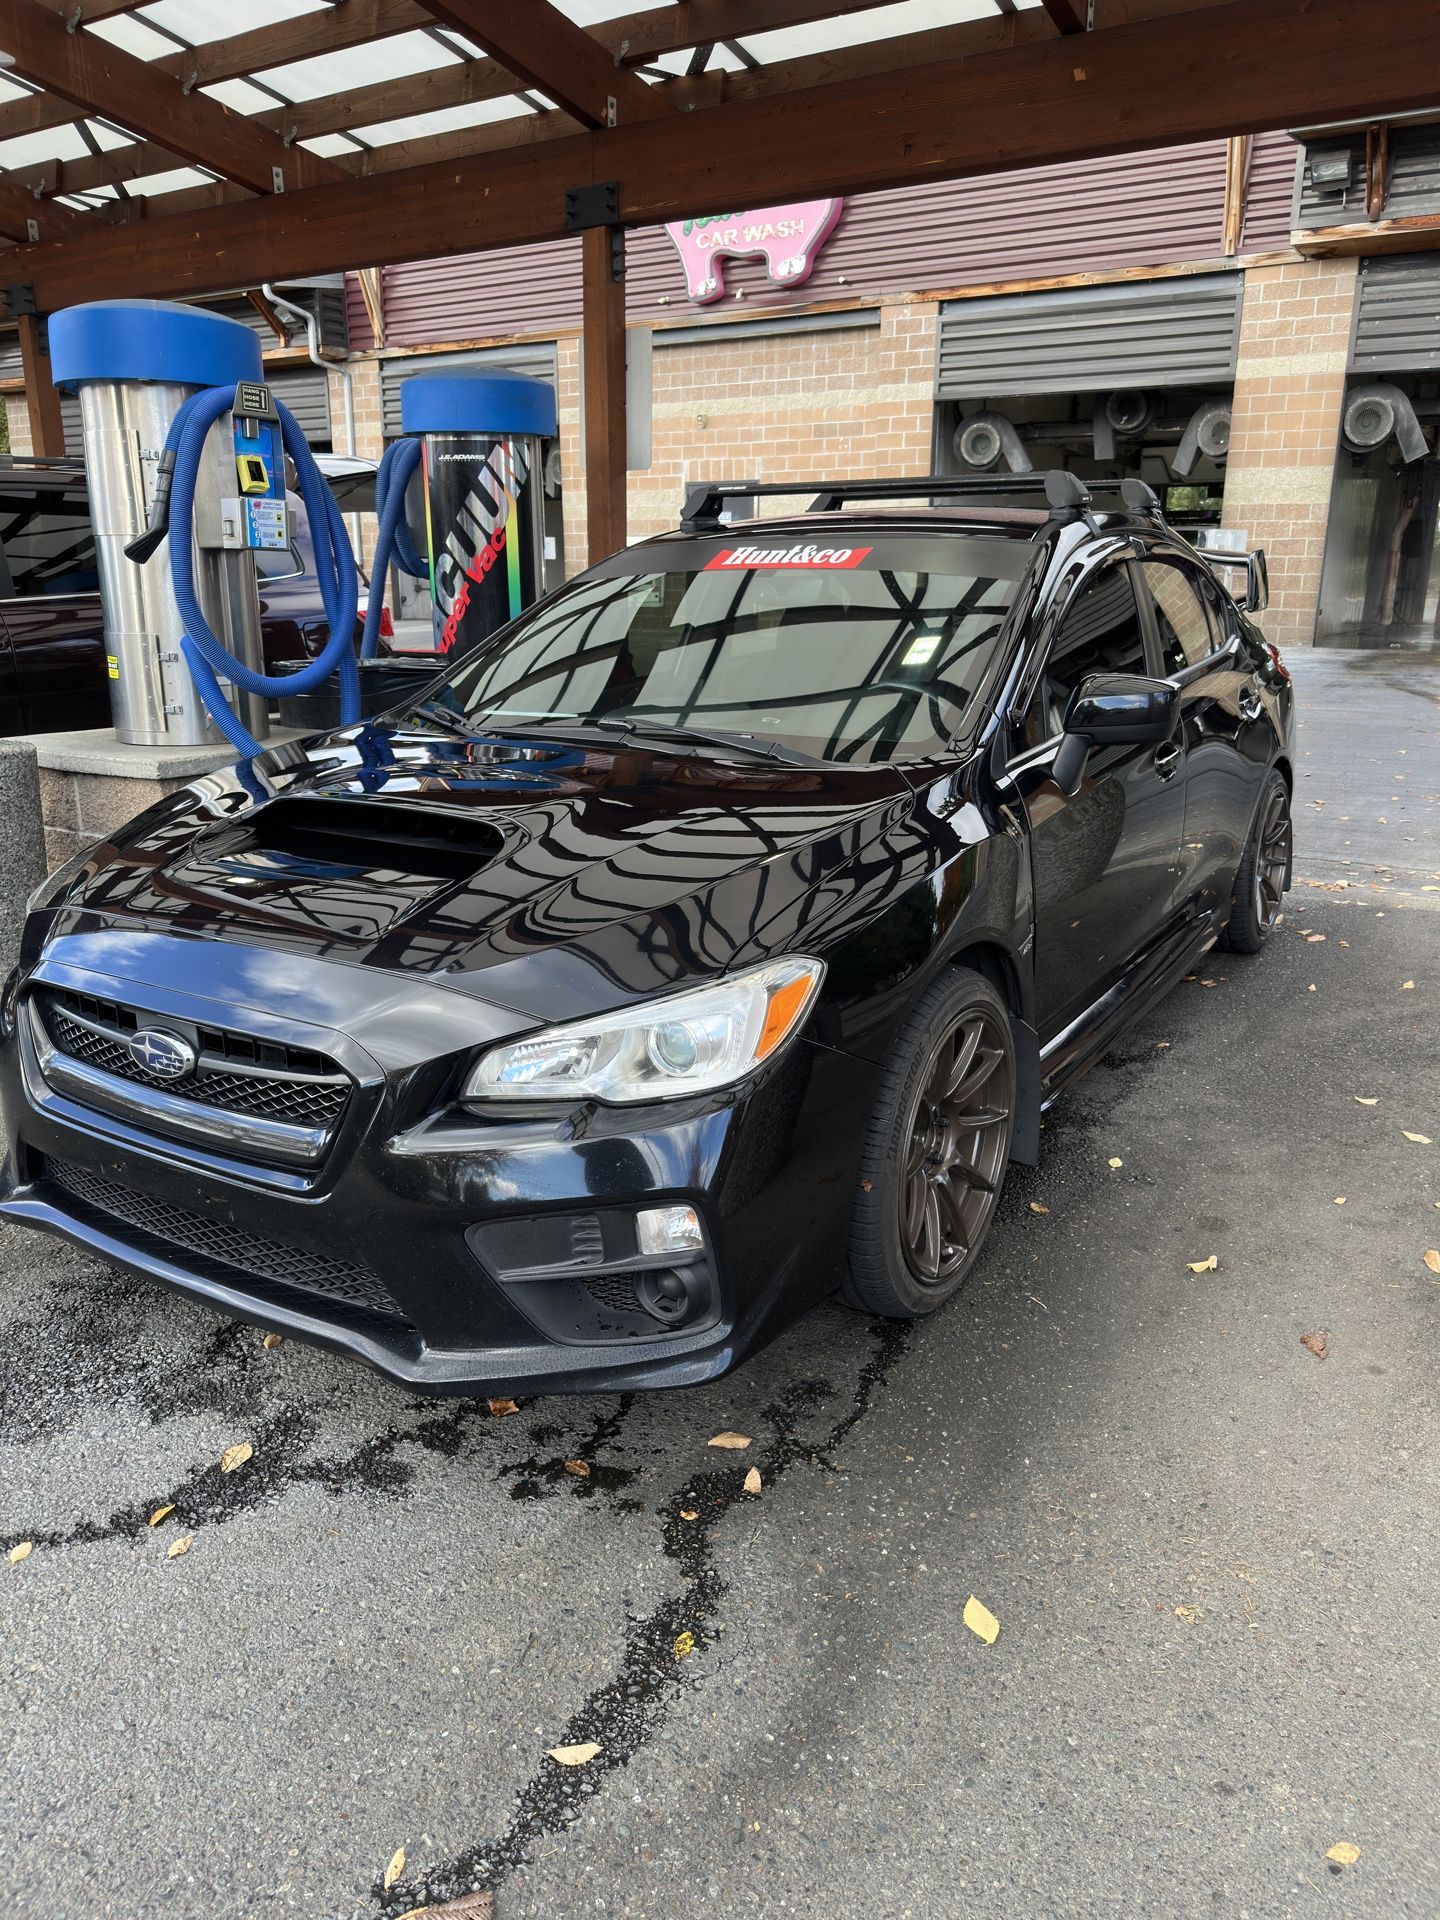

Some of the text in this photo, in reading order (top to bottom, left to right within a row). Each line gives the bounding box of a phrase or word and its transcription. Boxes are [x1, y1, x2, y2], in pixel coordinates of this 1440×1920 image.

[696, 228, 738, 249] CAR
[743, 219, 805, 242] WASH
[721, 544, 853, 565] Hunt&co
[436, 527, 507, 653] uper Vac
